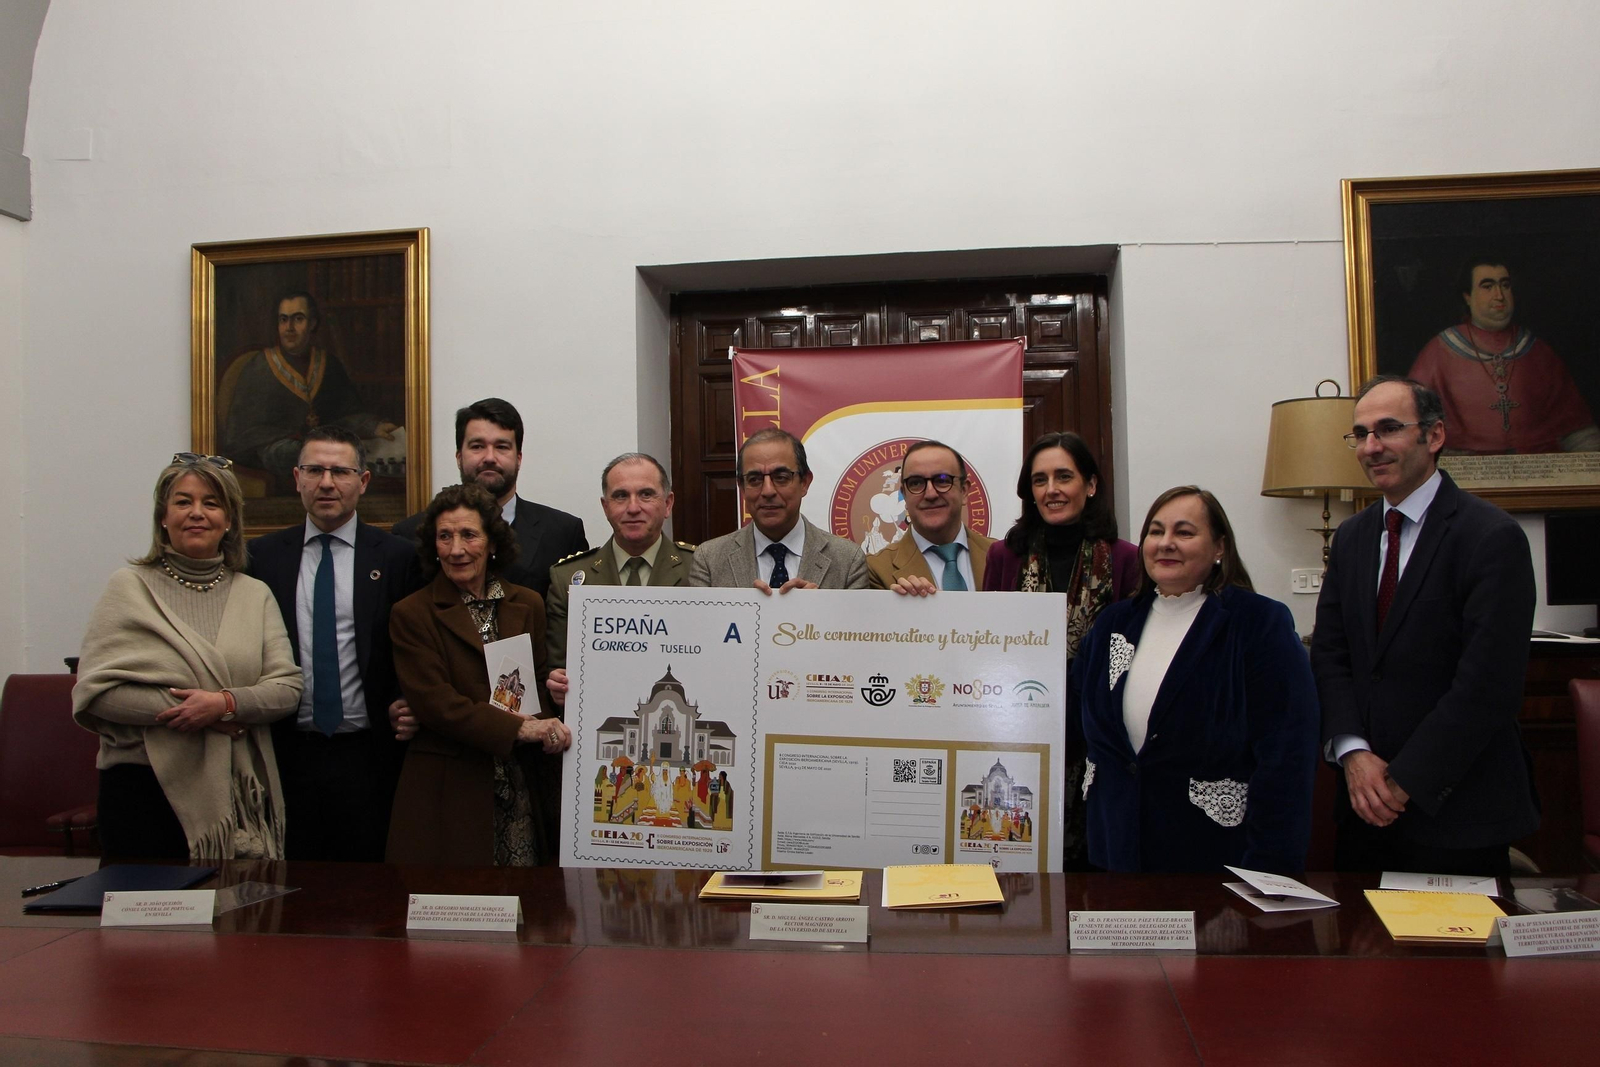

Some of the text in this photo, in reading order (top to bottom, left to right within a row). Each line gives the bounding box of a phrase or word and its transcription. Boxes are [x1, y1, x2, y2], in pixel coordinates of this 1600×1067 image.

[593, 614, 669, 636] ESPAÑA
[723, 622, 742, 644] A
[772, 622, 1050, 652] Sello conmemorativo y tarjeta postal
[660, 644, 702, 655] TUSELLO
